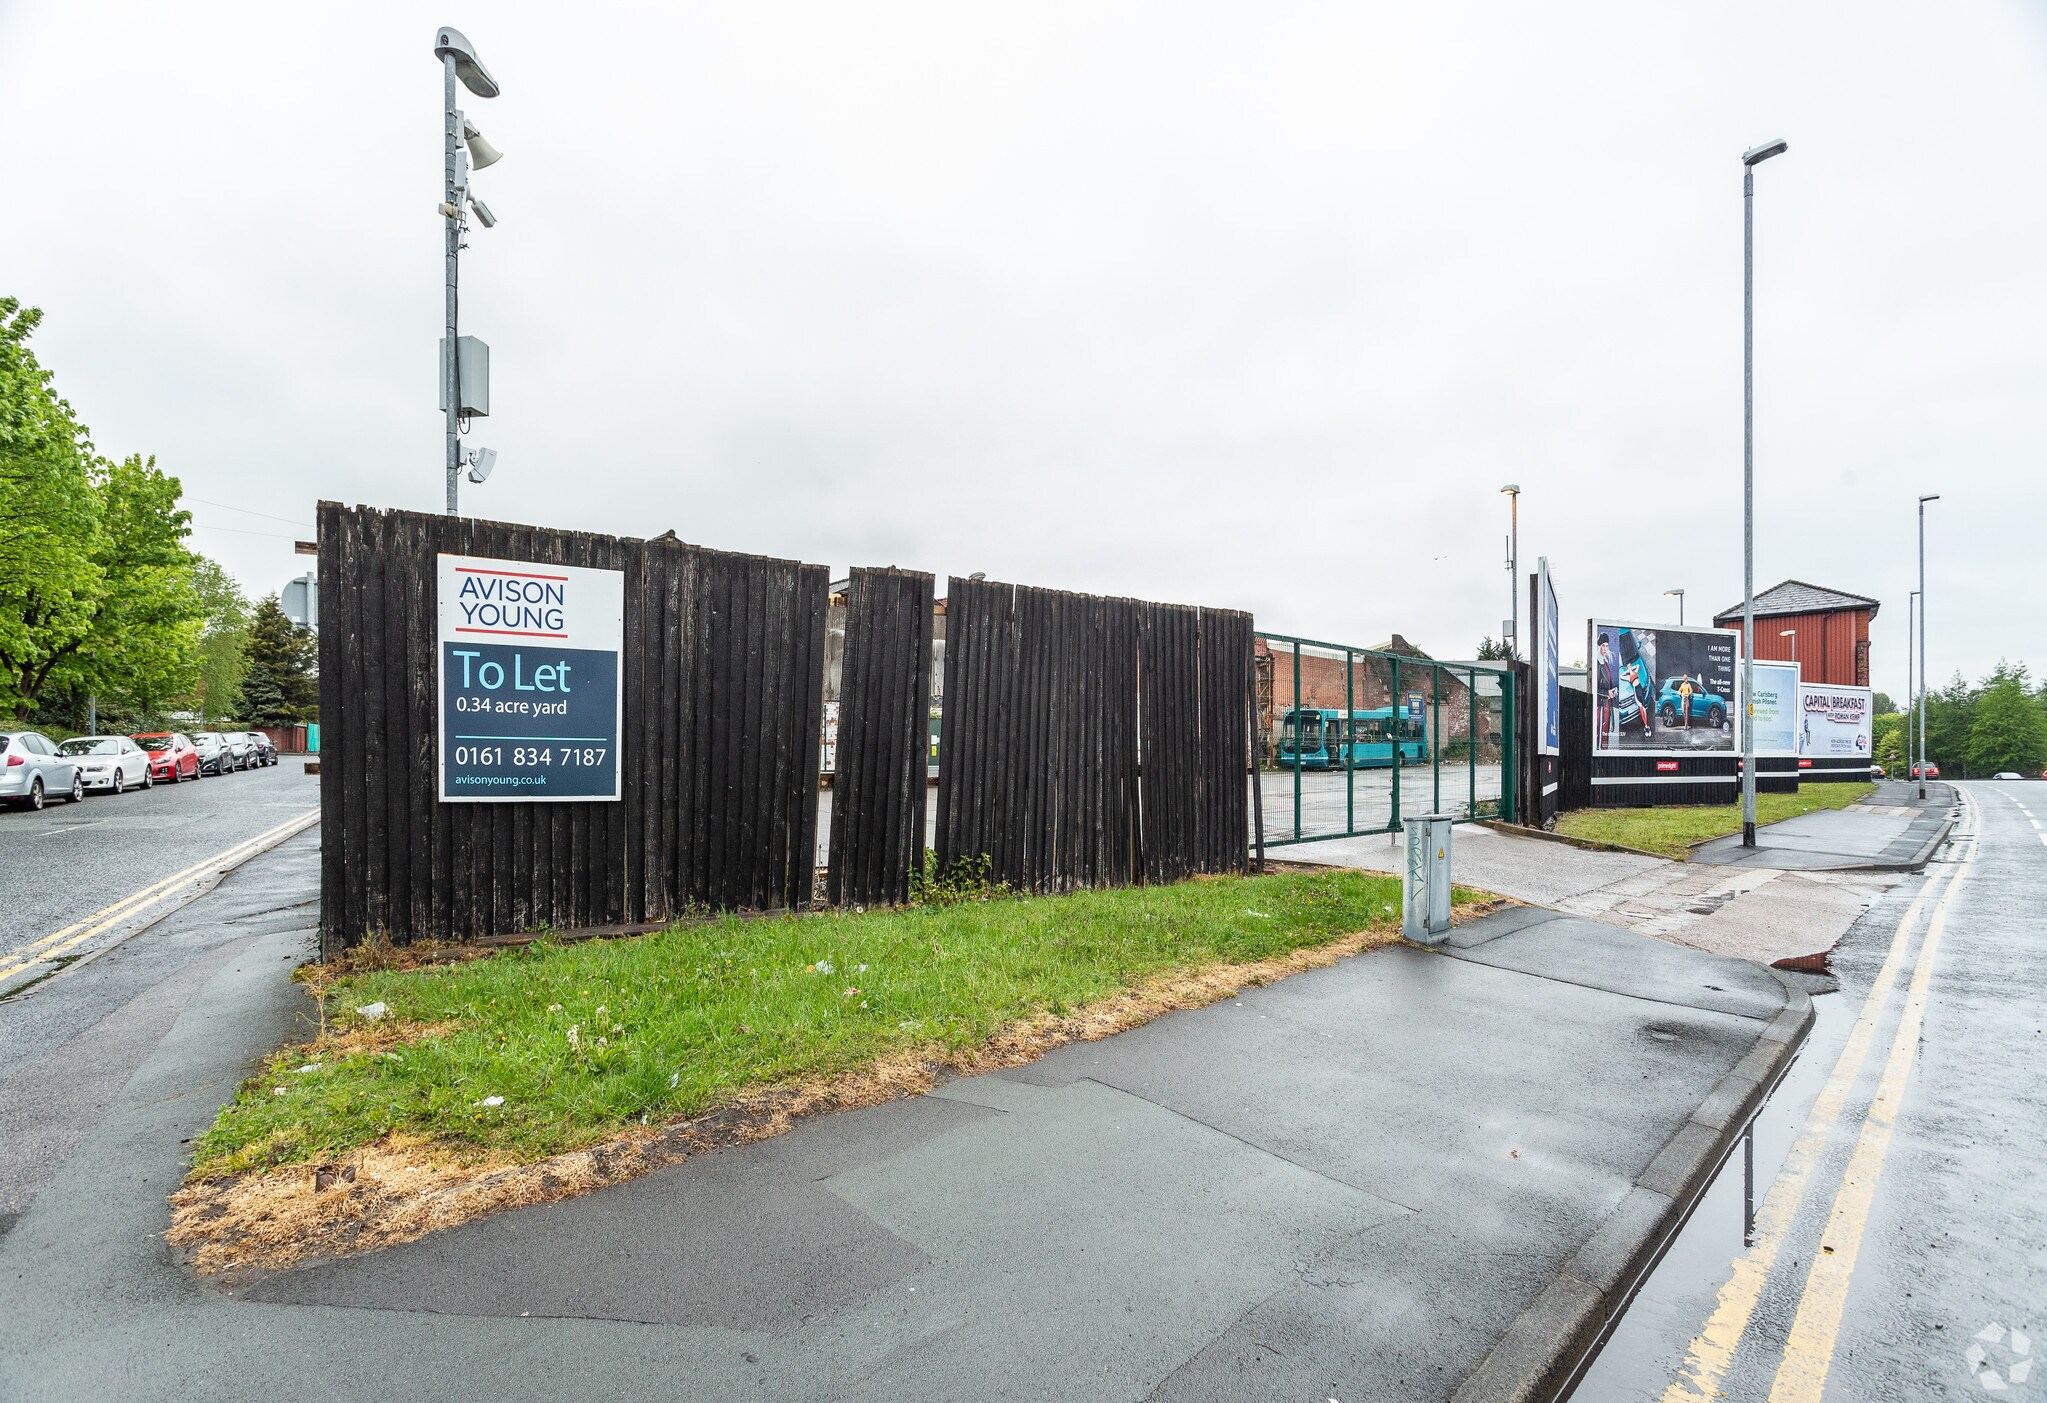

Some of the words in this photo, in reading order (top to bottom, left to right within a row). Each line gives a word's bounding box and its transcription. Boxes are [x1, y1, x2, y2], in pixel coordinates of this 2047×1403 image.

[459, 576, 564, 606] AVISON
[459, 601, 564, 631] YOUNG
[1708, 654, 1721, 662] THAN
[452, 650, 505, 691] To
[514, 653, 572, 693] Let
[1757, 690, 1778, 699] Carlsberg
[1805, 694, 1831, 708] CAPITAL
[1832, 695, 1865, 711] BREAKFAST
[456, 696, 492, 713] 0.34
[495, 700, 529, 714] acre
[532, 699, 567, 718] yard
[1834, 711, 1849, 720] ROMAN
[455, 746, 502, 766] 0161
[513, 747, 552, 766] 834
[560, 747, 607, 766] 7187
[455, 774, 547, 787] avisonyoung.co.uk
